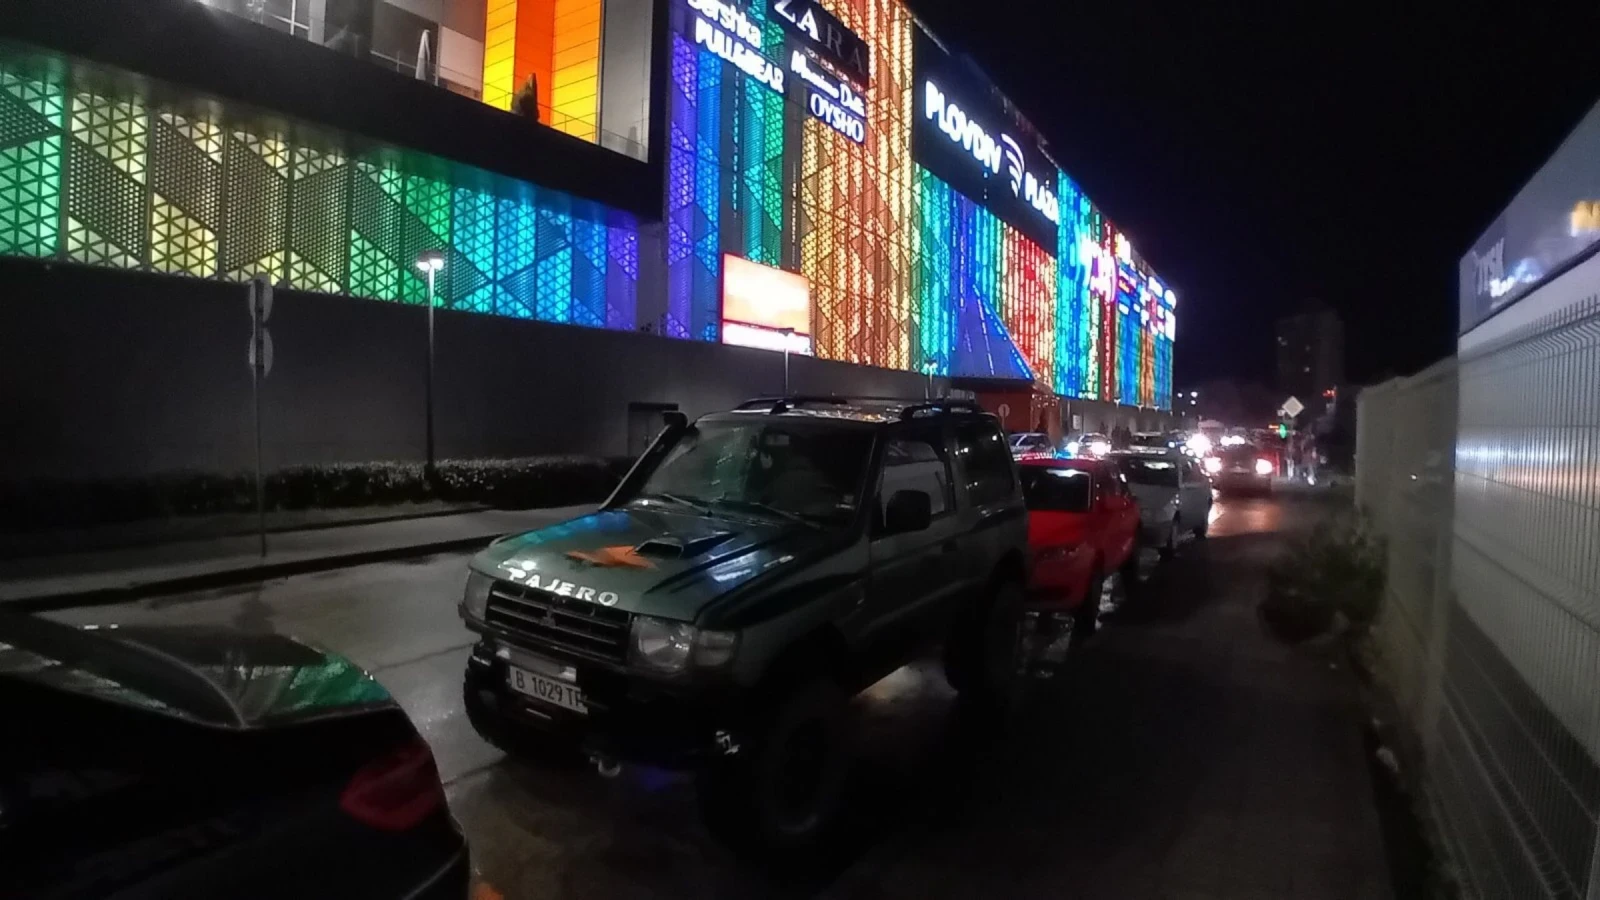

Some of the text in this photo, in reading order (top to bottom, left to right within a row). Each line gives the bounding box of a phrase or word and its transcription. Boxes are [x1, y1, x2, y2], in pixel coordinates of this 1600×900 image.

[810, 92, 865, 143] OYSHO
[925, 80, 1003, 175] PLOVDIV
[507, 567, 619, 607] PAJERO
[515, 670, 525, 690] B
[531, 676, 564, 702] 1029
